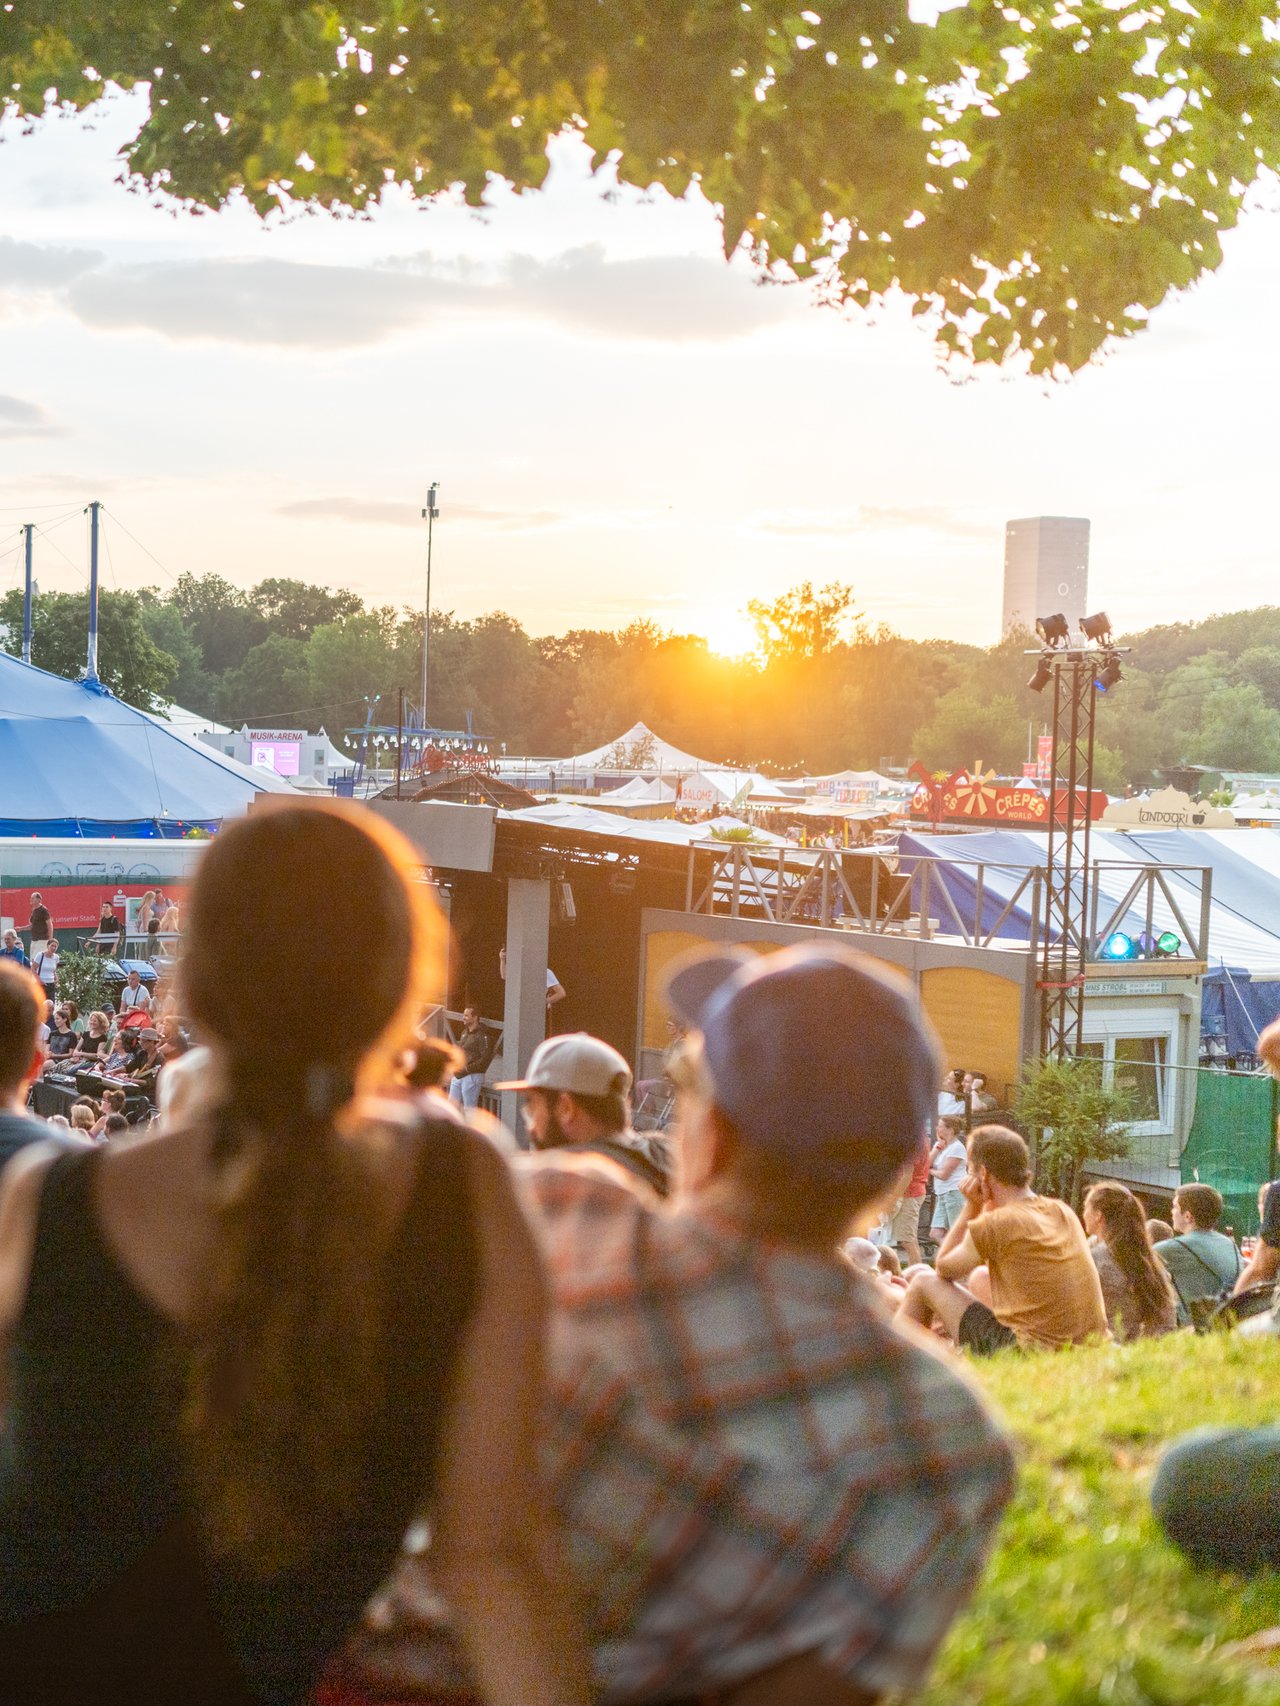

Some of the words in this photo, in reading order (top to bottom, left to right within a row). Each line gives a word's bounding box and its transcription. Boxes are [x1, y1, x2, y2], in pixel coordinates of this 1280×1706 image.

[250, 732, 303, 741] MUSIK-ARENA
[912, 791, 958, 811] CRES
[995, 791, 1045, 817] CRÊPES
[1007, 811, 1032, 819] WORLD
